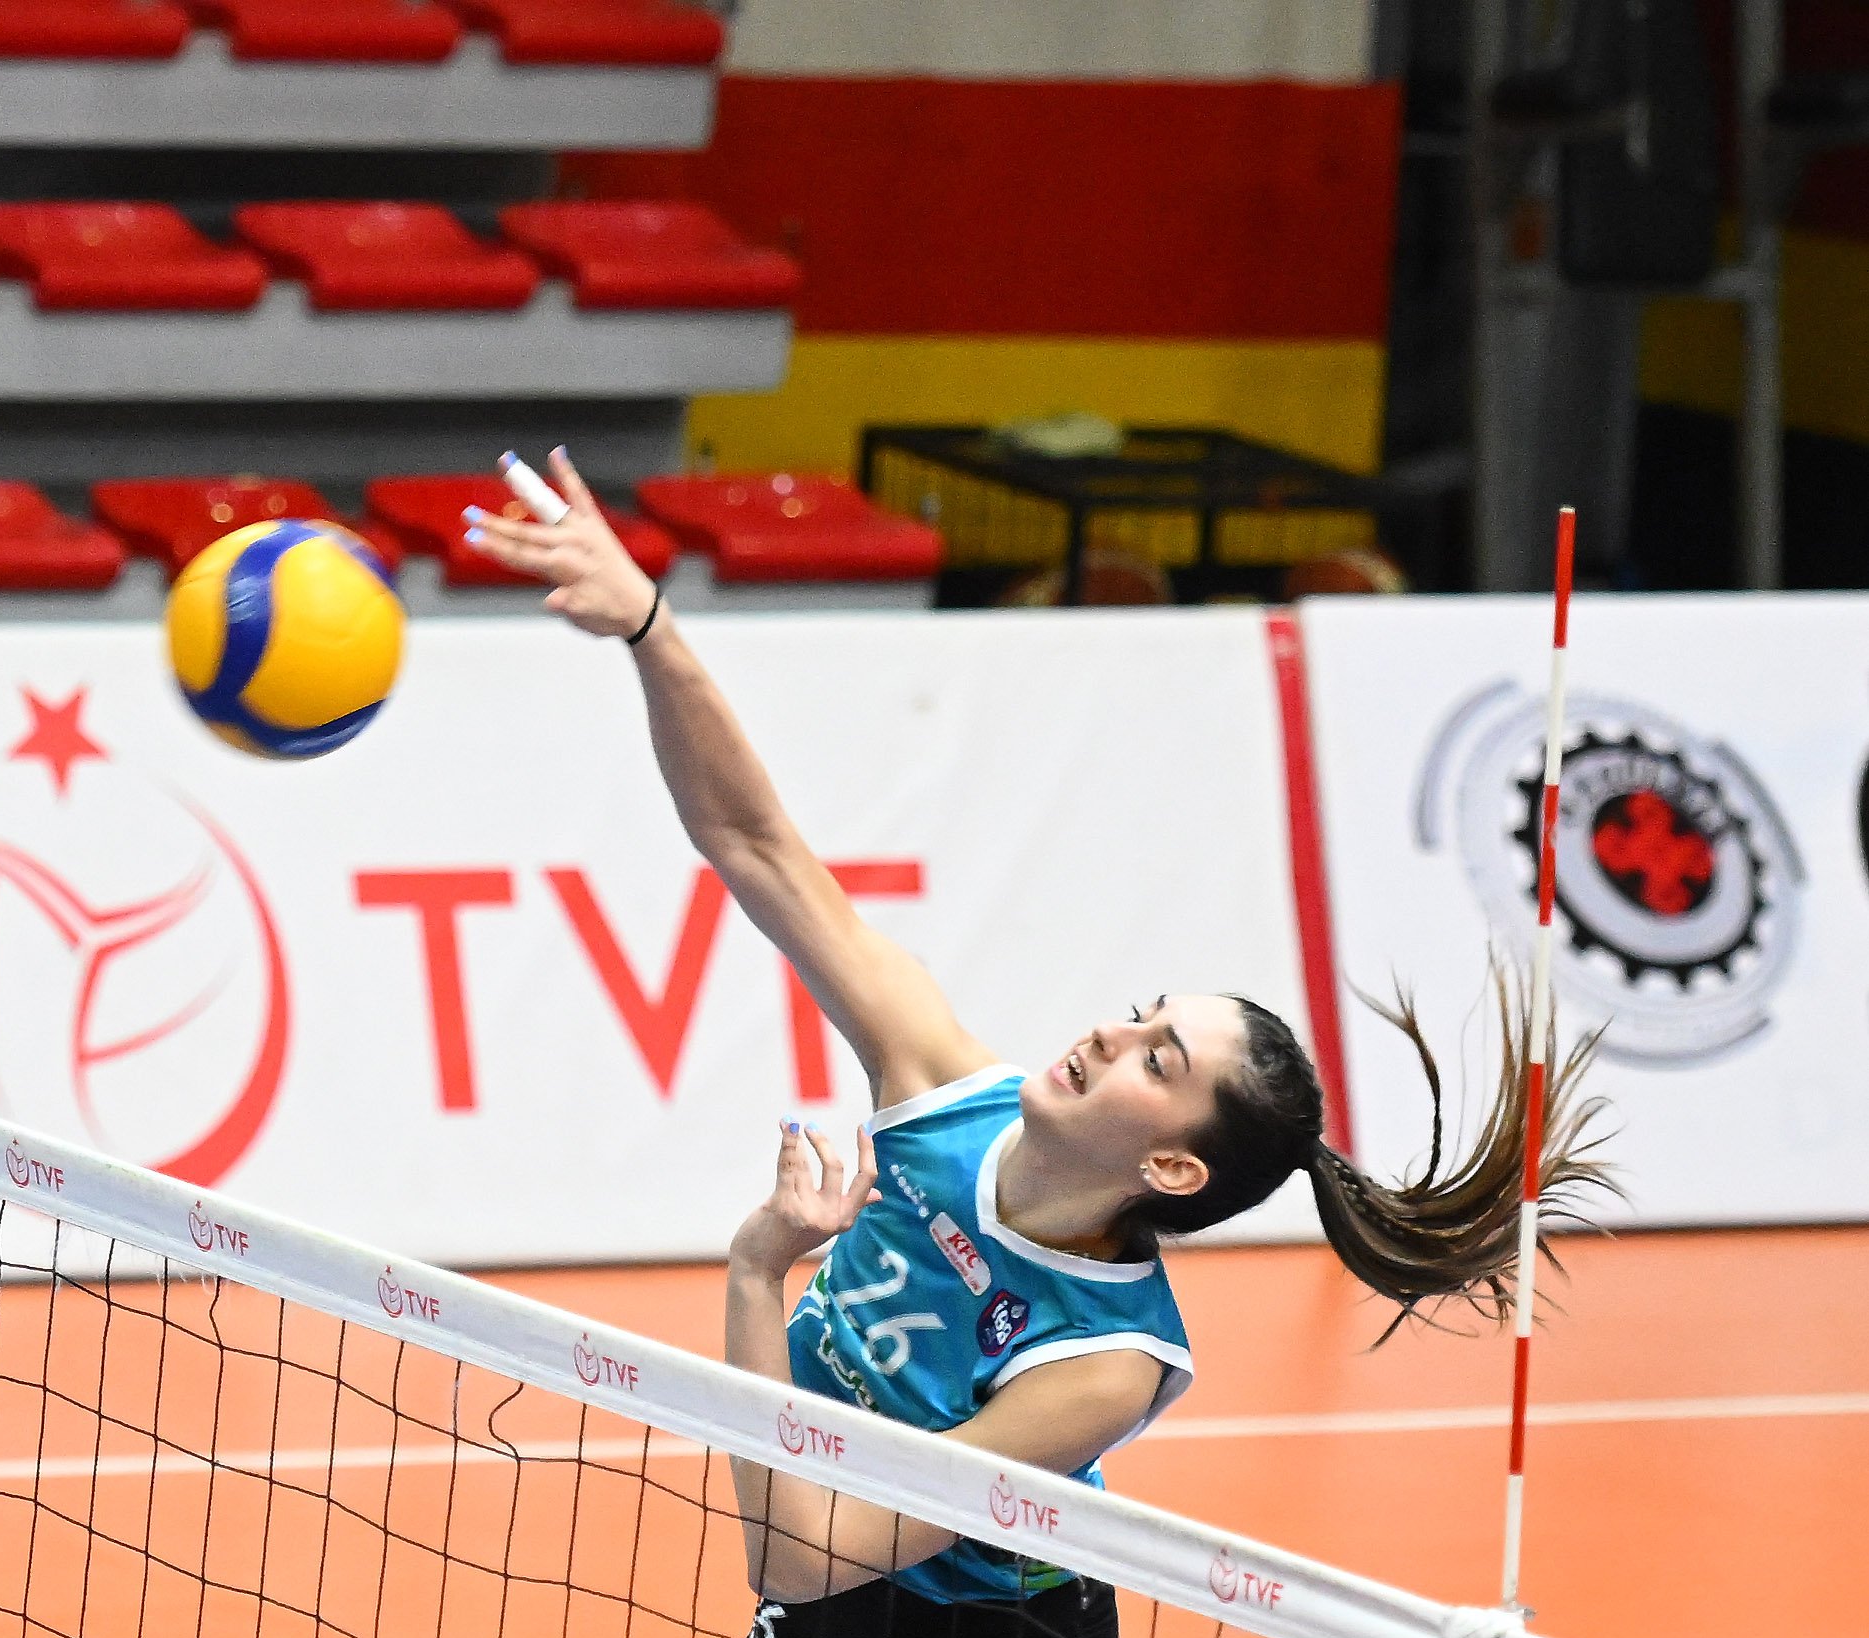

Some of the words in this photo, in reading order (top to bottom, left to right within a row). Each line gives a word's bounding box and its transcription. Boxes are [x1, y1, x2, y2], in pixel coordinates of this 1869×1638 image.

[31, 1159, 65, 1192] TVF
[215, 1223, 249, 1256] TVF
[947, 1232, 978, 1268] KFC
[405, 1289, 441, 1322] TVF
[833, 1249, 948, 1376] 26
[603, 1356, 639, 1391] TVF
[807, 1426, 845, 1461] TVF
[1020, 1498, 1059, 1534] TVF
[1243, 1573, 1283, 1610] TVF
